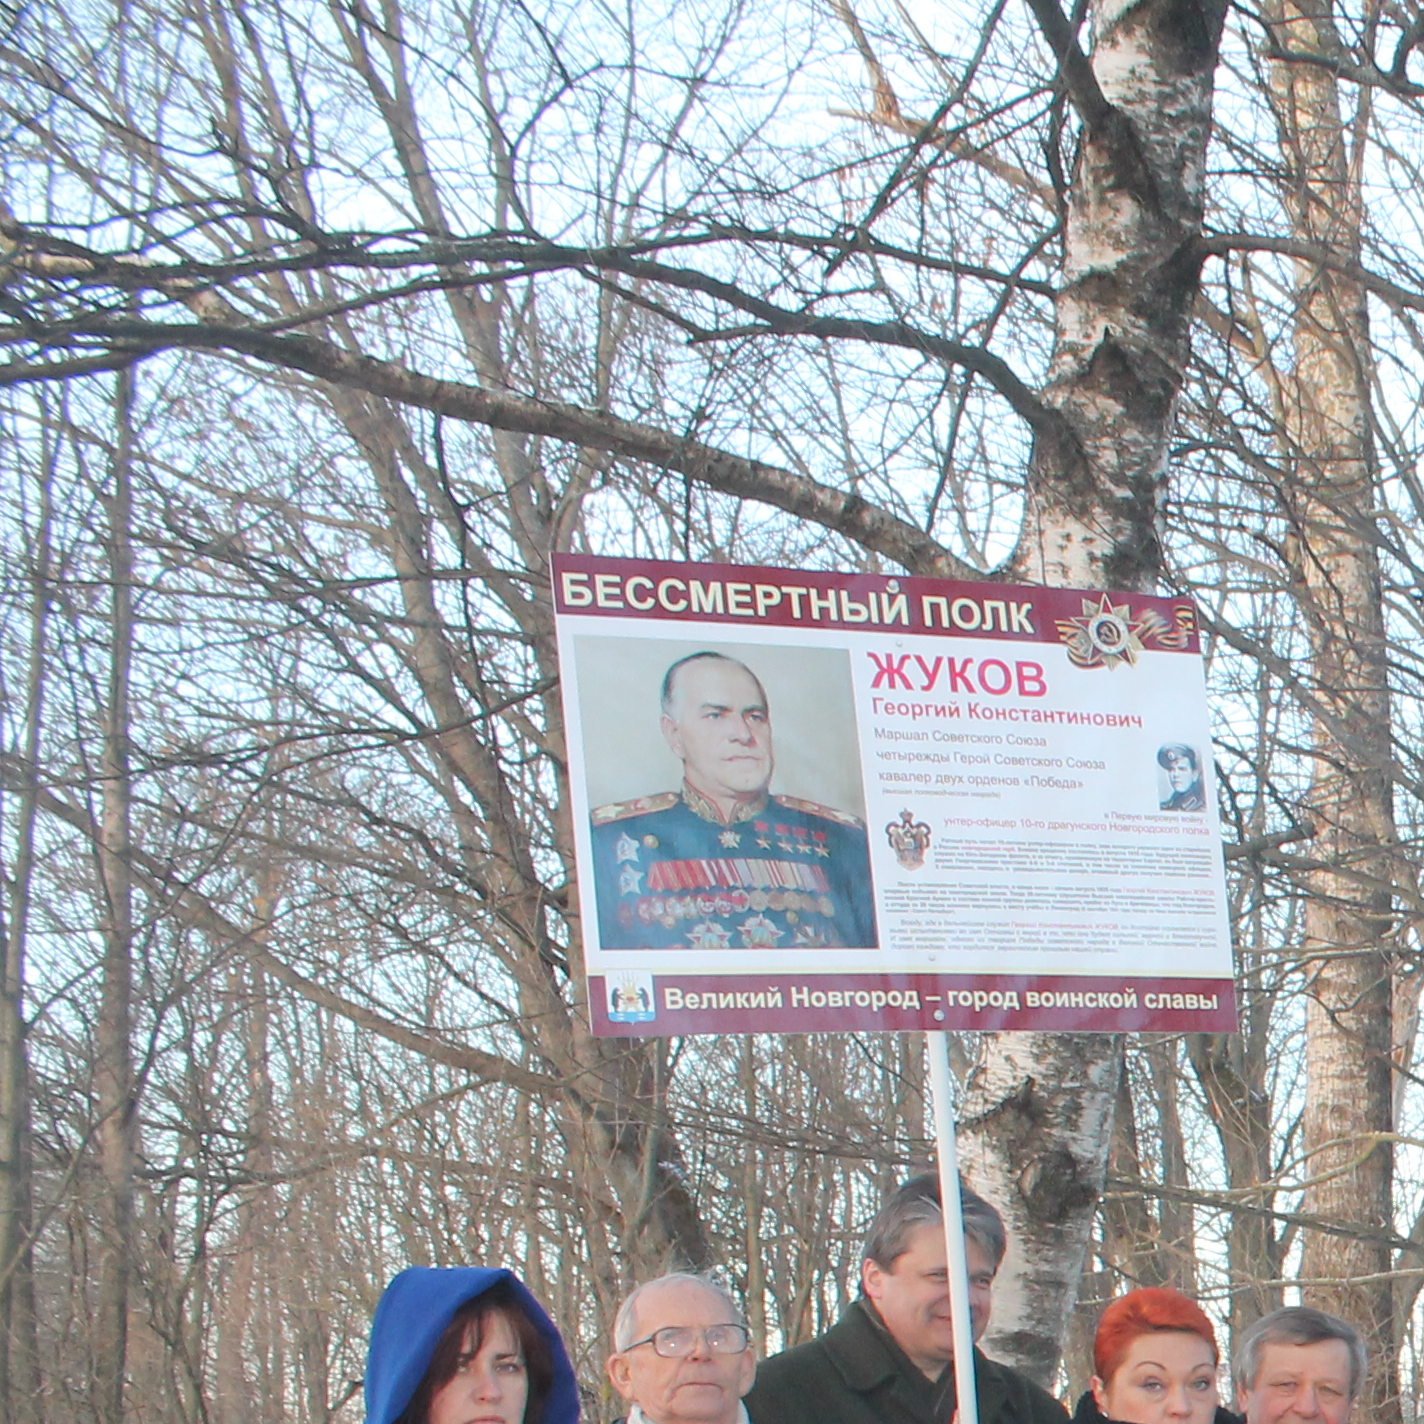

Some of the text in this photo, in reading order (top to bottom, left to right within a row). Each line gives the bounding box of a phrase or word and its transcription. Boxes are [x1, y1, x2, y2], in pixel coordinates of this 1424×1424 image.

[561, 572, 1036, 635] БЕССМЕРТНЫЙ ПОЛК
[867, 652, 1048, 697] ЖУКОВ
[872, 697, 1143, 729] Георгий Константинович
[874, 727, 1047, 747] Маршал Советского Союза
[876, 750, 1106, 770] четырежды Герой Советского Союза
[878, 771, 1084, 790] кавалер двух орденов «Победа»
[943, 817, 1210, 837] унтер-офицер 10-го драгунского Новгородского полка
[664, 985, 783, 1010] Великий
[791, 985, 921, 1012] Новгород
[948, 989, 1020, 1012] город
[1026, 987, 1138, 1009] воинской
[1144, 991, 1219, 1010] славы
